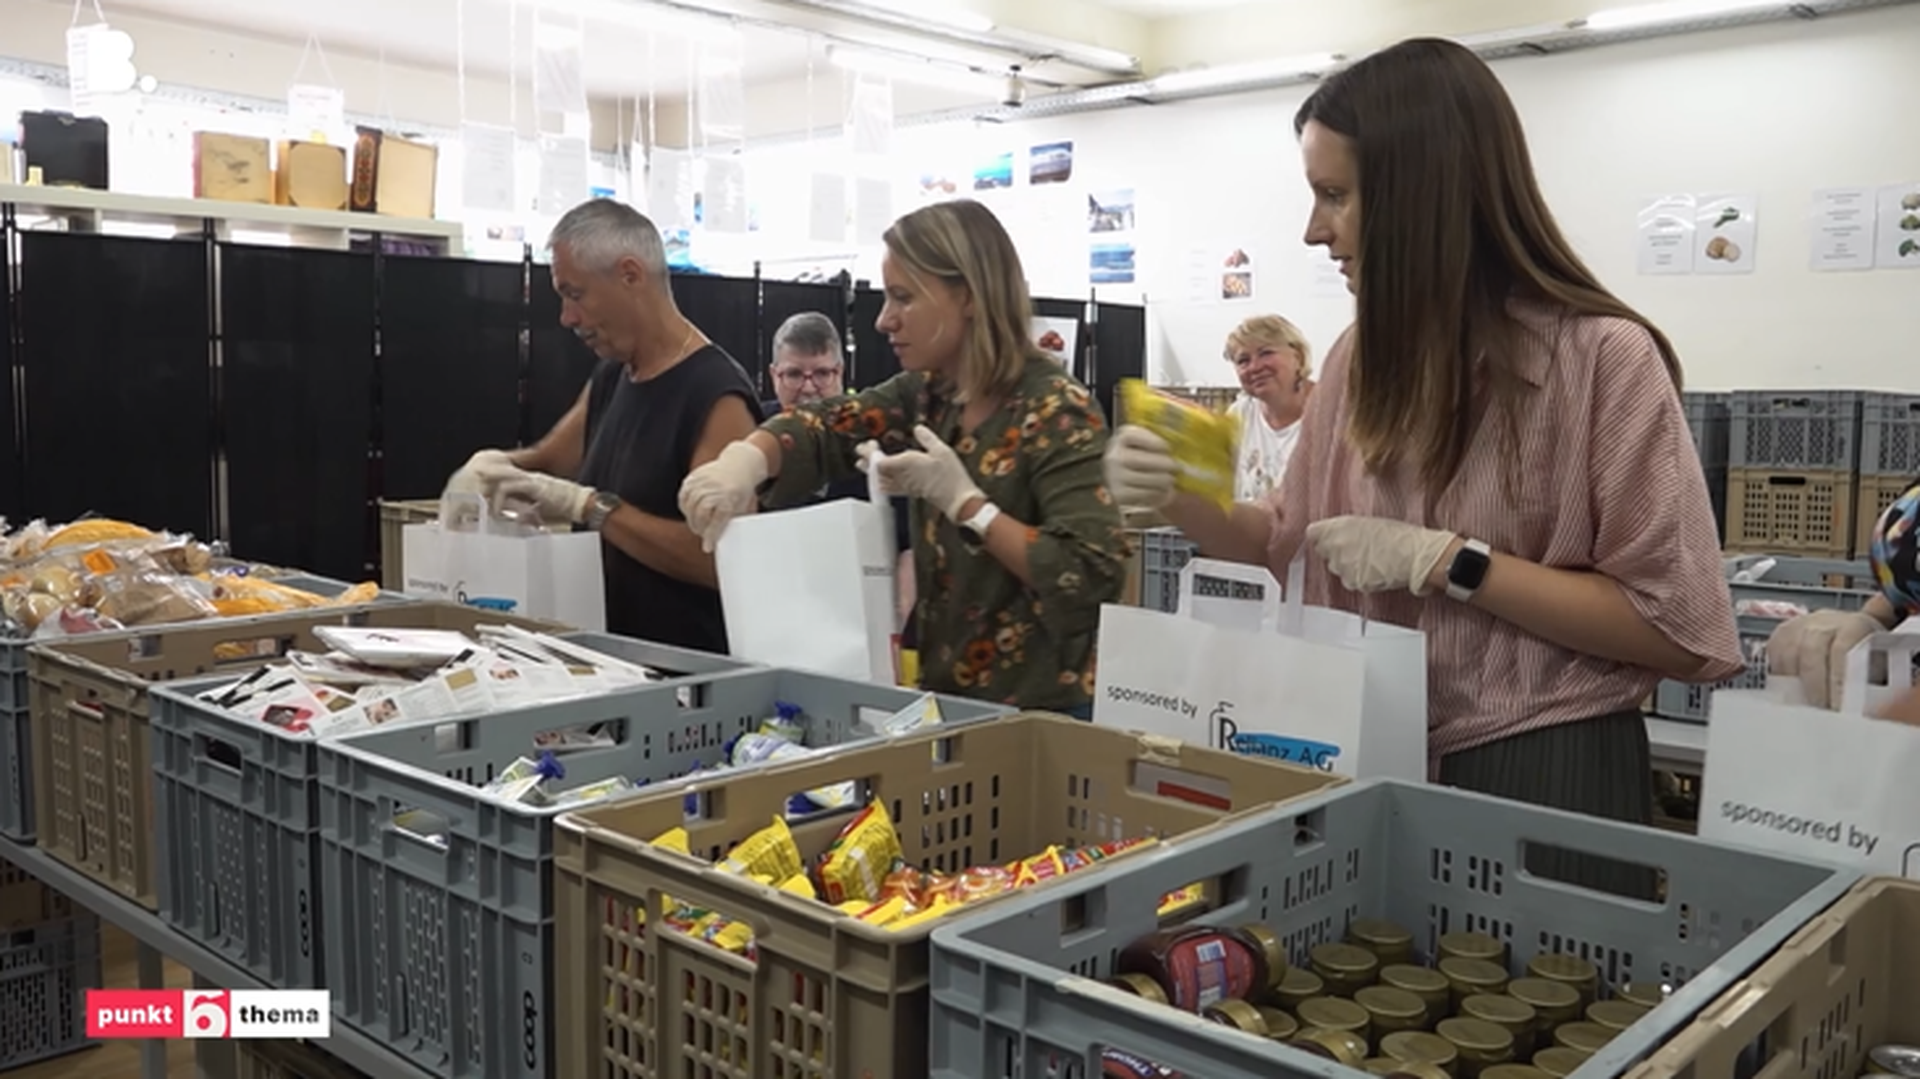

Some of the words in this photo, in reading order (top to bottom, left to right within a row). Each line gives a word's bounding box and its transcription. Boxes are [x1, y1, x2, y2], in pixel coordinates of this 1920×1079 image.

[1107, 685, 1180, 712] sponsored
[1181, 699, 1198, 719] by
[1299, 746, 1334, 772] AG
[1721, 801, 1842, 843] sponsored
[1848, 825, 1879, 856] by
[523, 990, 538, 1070] coop
